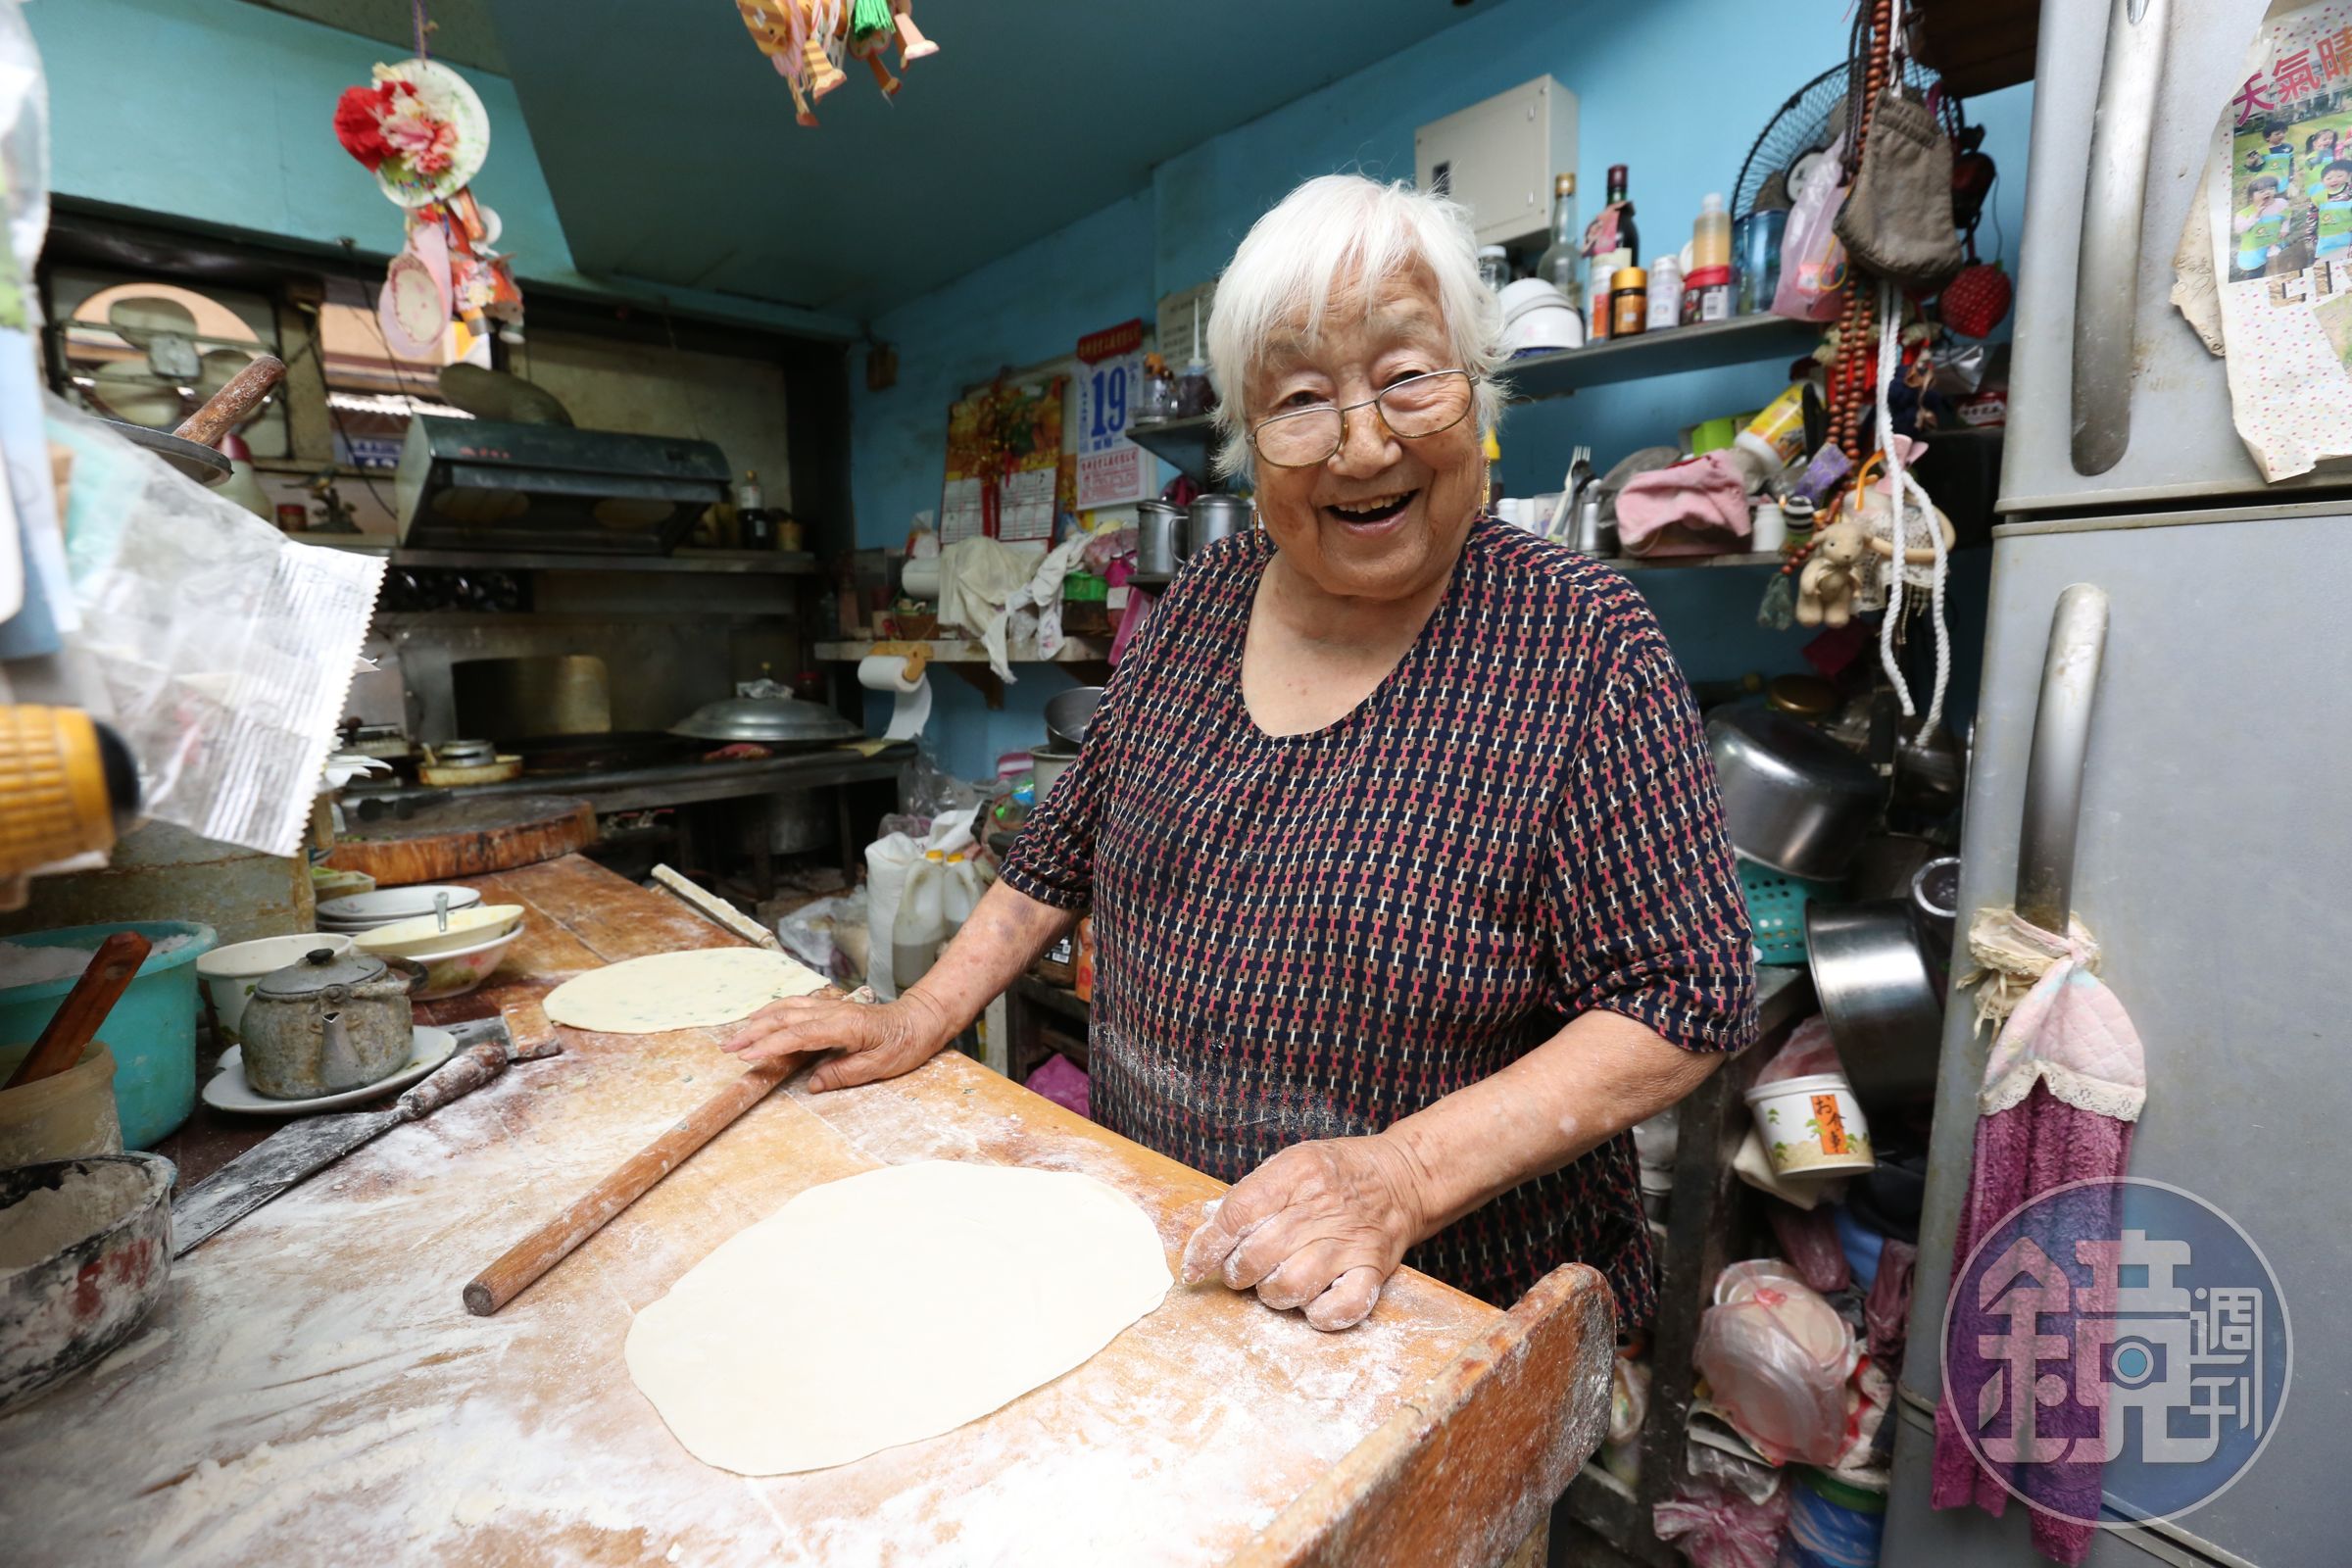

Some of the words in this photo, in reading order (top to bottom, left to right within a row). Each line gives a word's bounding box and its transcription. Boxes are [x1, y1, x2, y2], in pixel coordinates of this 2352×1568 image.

[2232, 25, 2352, 125] 天氣晴
[1091, 366, 1127, 437] 19
[1815, 1095, 1846, 1153] お食事
